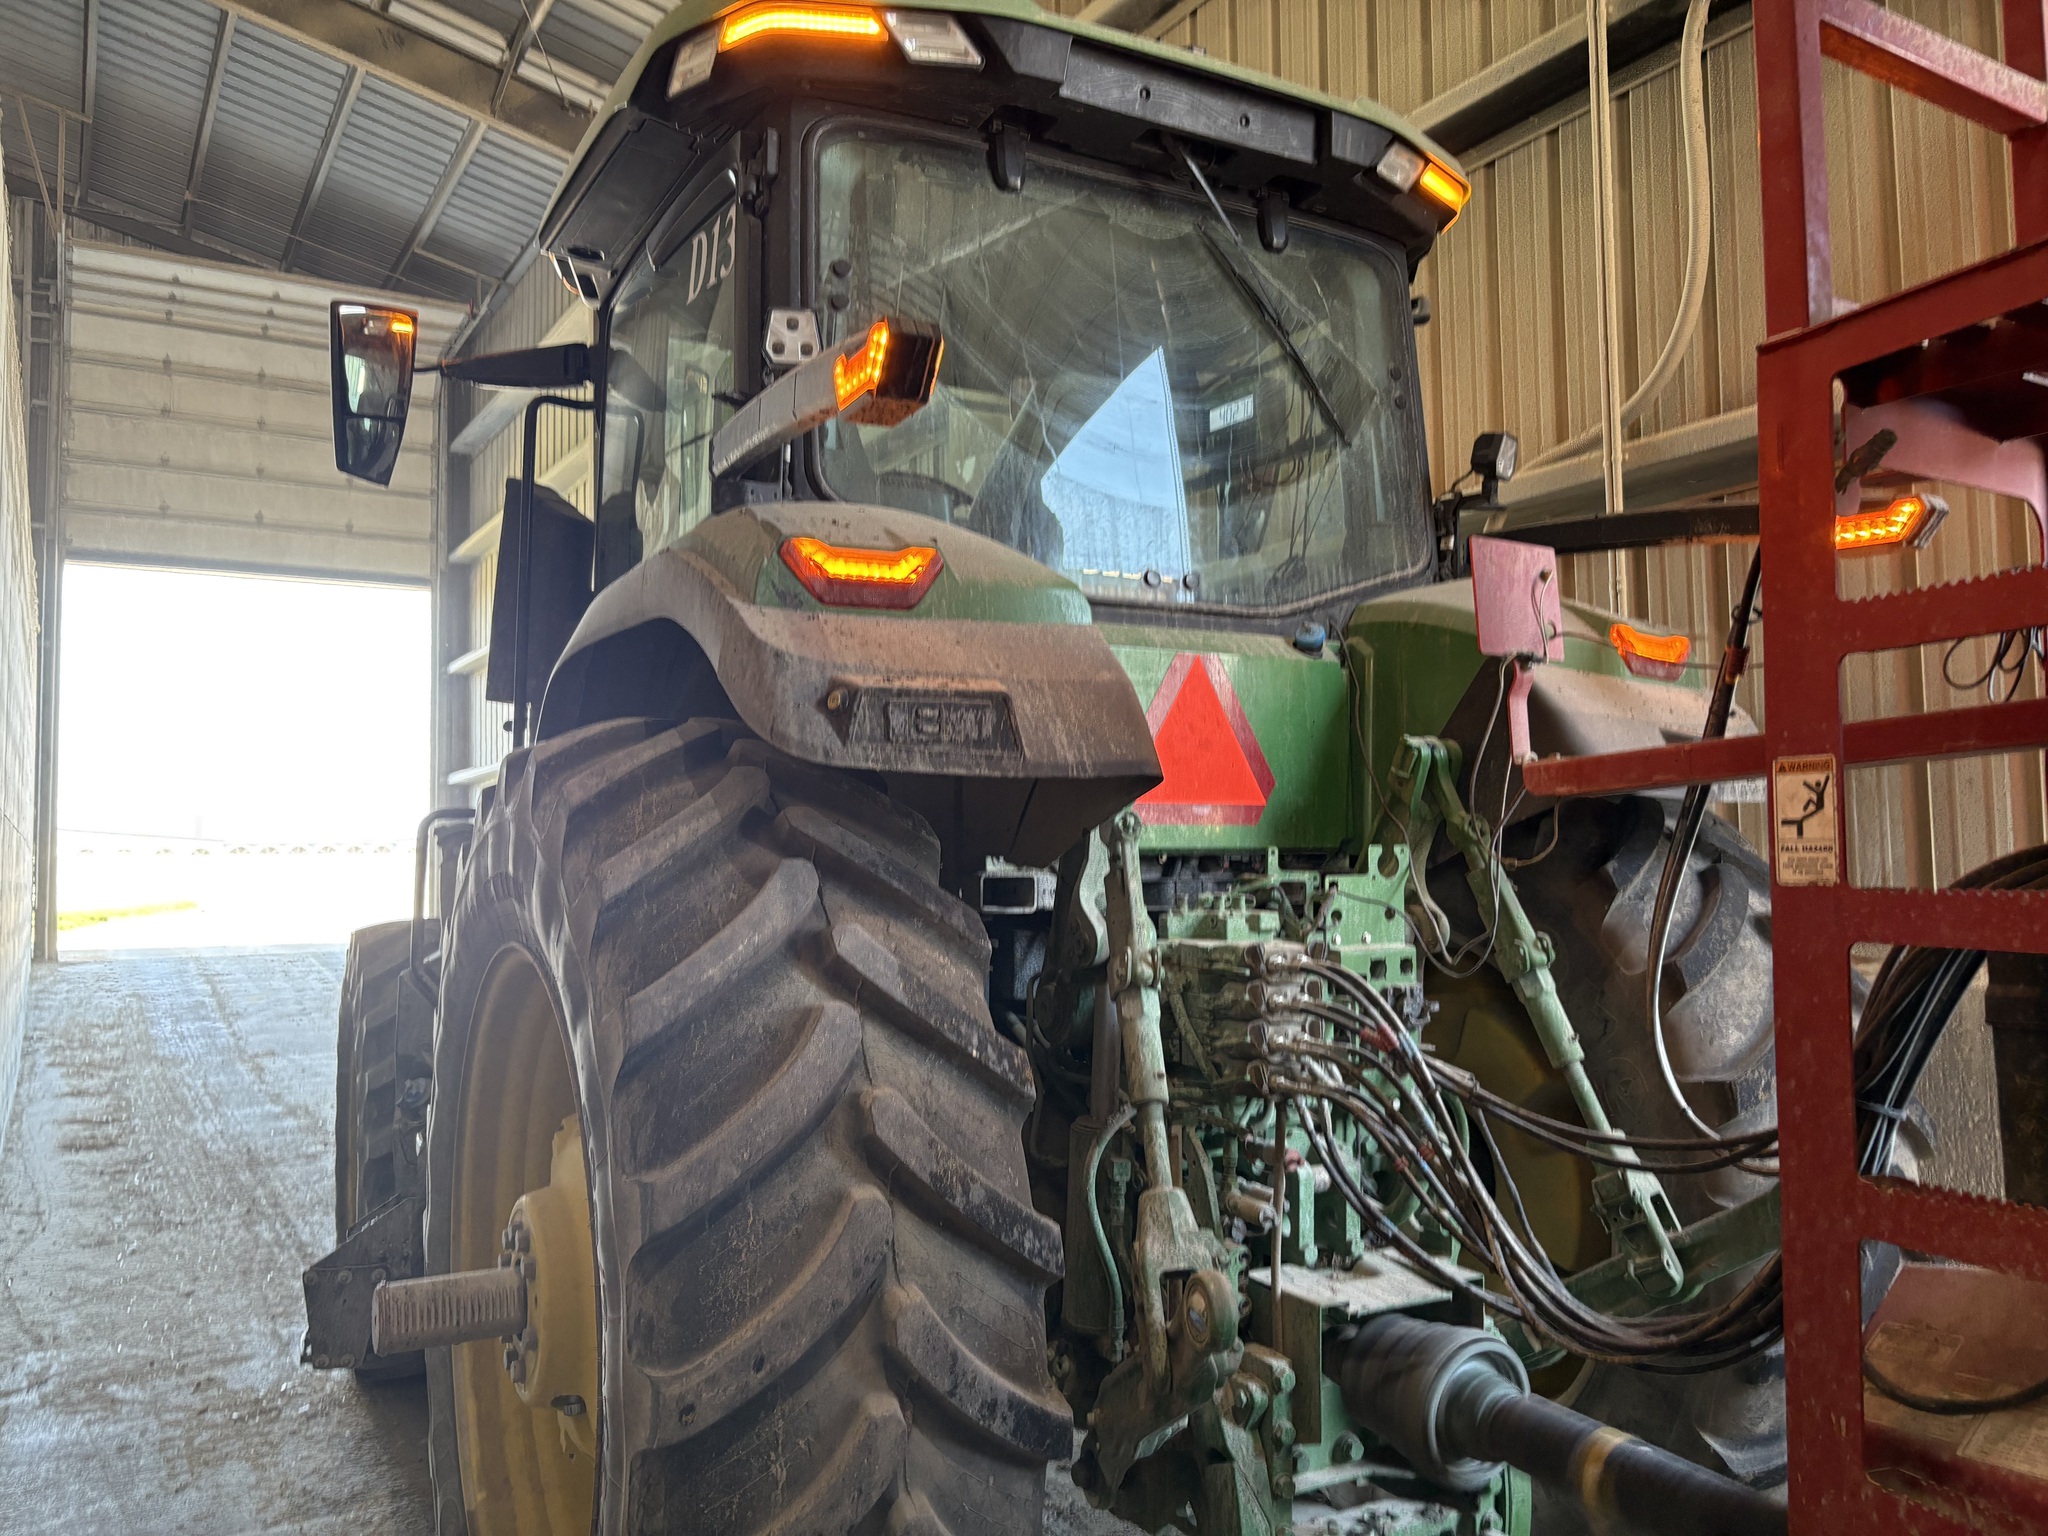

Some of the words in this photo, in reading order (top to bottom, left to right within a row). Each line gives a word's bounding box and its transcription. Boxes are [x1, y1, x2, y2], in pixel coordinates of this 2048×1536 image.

[686, 203, 737, 306] D13
[1788, 760, 1830, 772] WARNING
[1780, 844, 1799, 852] FALL
[1802, 844, 1833, 854] HAZARD
